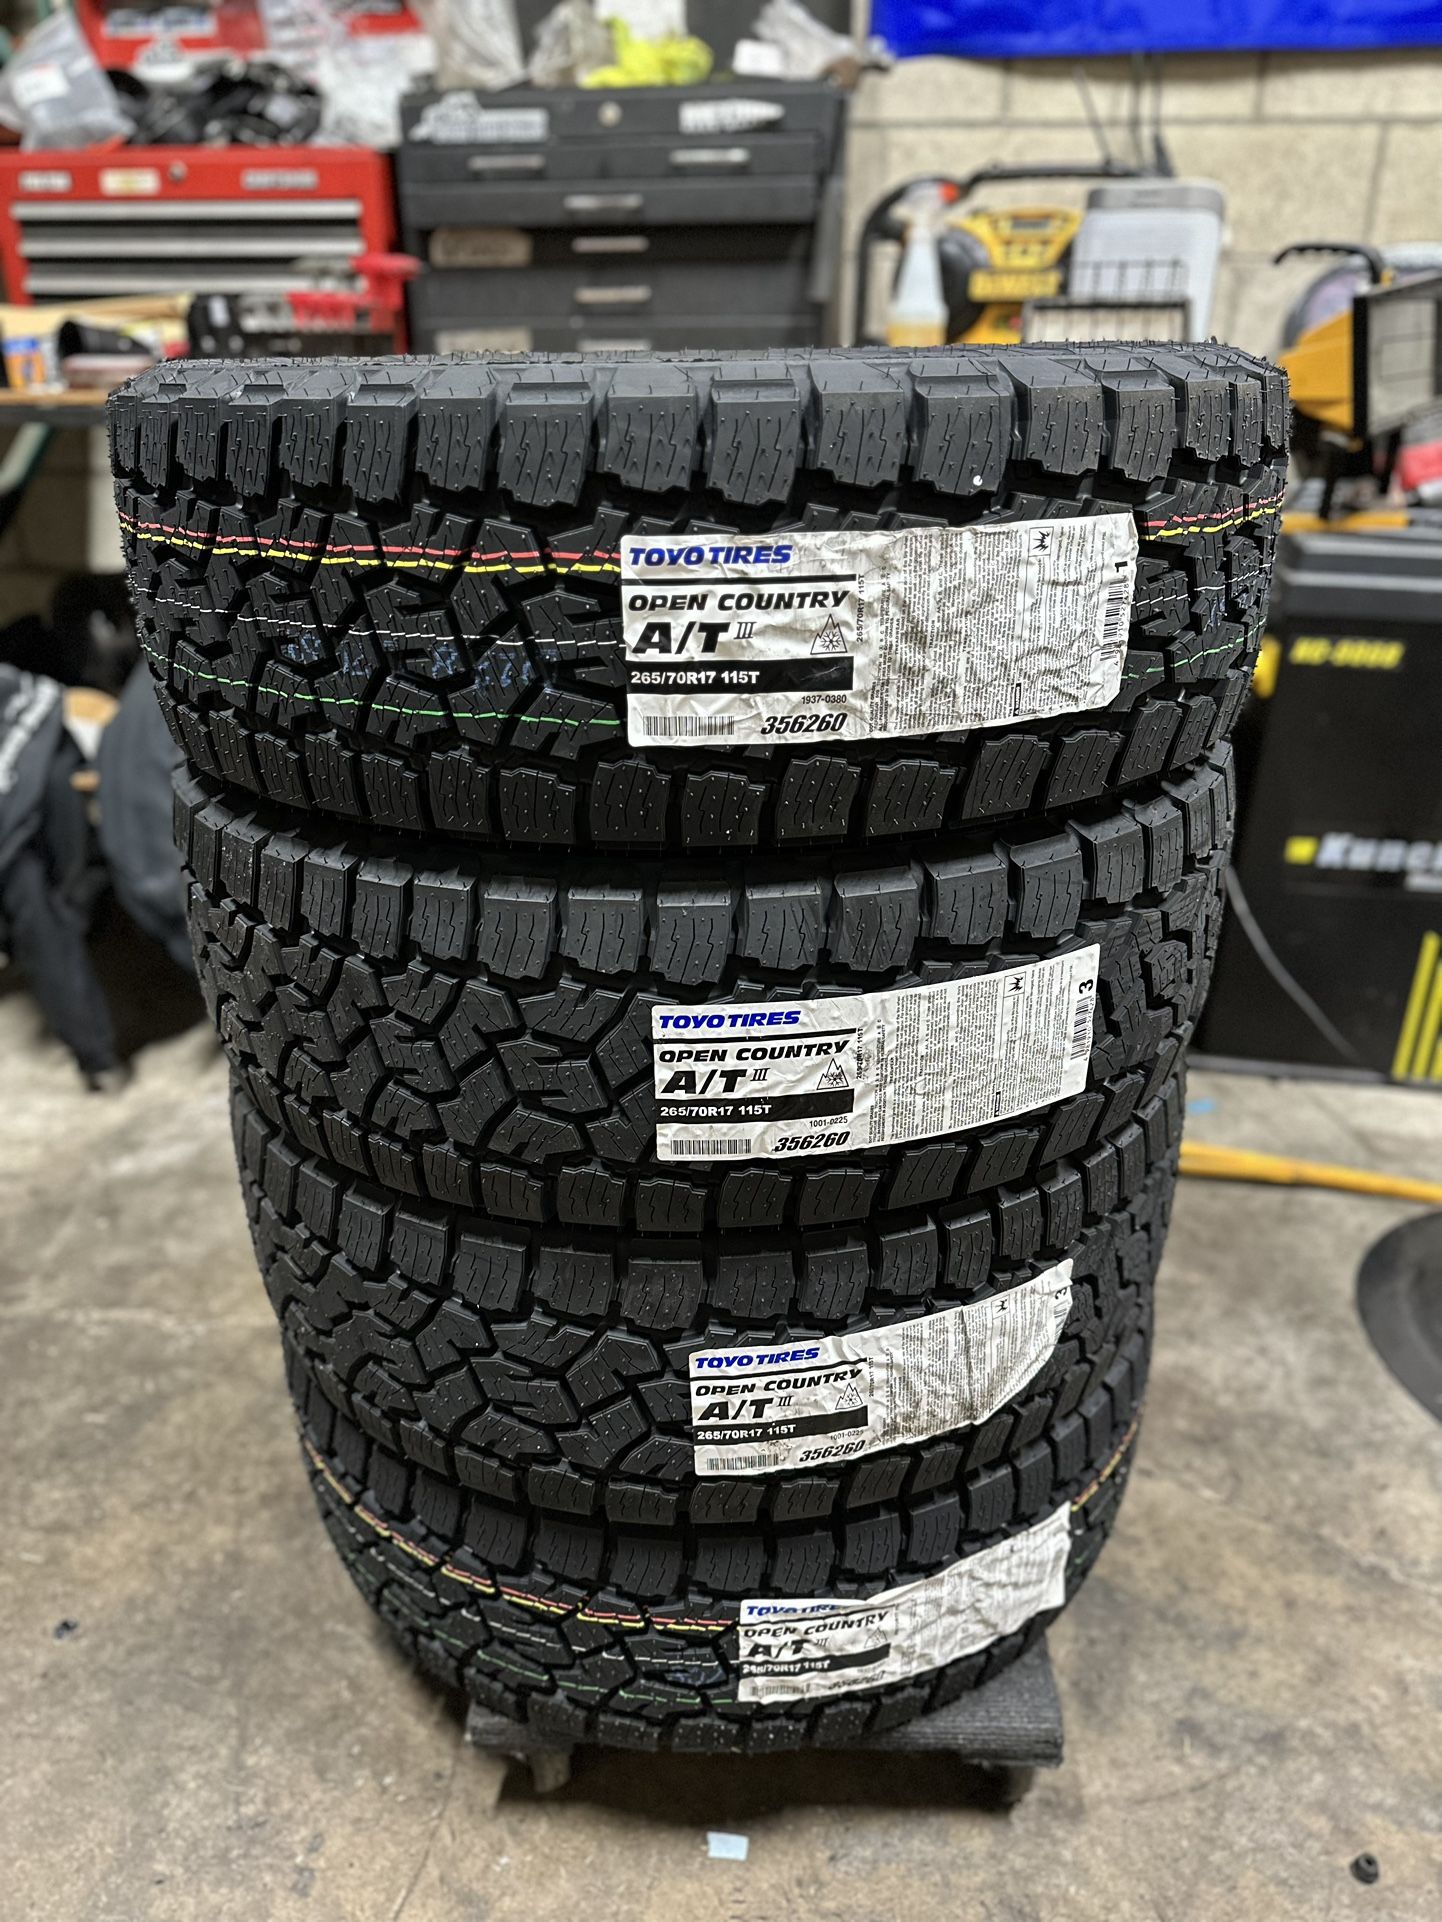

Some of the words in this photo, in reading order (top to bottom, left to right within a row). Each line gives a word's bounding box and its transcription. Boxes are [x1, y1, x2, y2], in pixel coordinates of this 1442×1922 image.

[857, 574, 865, 595] 115T
[628, 593, 708, 612] OPEN
[717, 590, 850, 612] COUNTRY
[856, 597, 865, 643] 265/70R17
[631, 620, 732, 655] A/T
[630, 671, 717, 685] 265/70R17
[720, 671, 760, 684] 115T
[801, 694, 847, 705] 1937-0380
[760, 712, 848, 735] 356260
[1078, 978, 1094, 994] 3
[658, 1049, 728, 1063] OPEN
[735, 1040, 850, 1061] COUNTRY
[660, 1069, 748, 1095] A/T
[660, 1105, 734, 1117] 265/70R17
[738, 1104, 772, 1116] 115T
[808, 1115, 848, 1128] 1001-0225
[774, 1131, 851, 1153] 356260
[695, 1383, 756, 1397] OPEN
[763, 1368, 864, 1392] COUNTRY
[697, 1397, 774, 1421] A/T
[697, 1428, 763, 1441] 265/70R17
[766, 1424, 797, 1437] 115T
[799, 1440, 867, 1462] 356260
[743, 1626, 798, 1638] OPEN
[803, 1611, 889, 1636] COUNTRY
